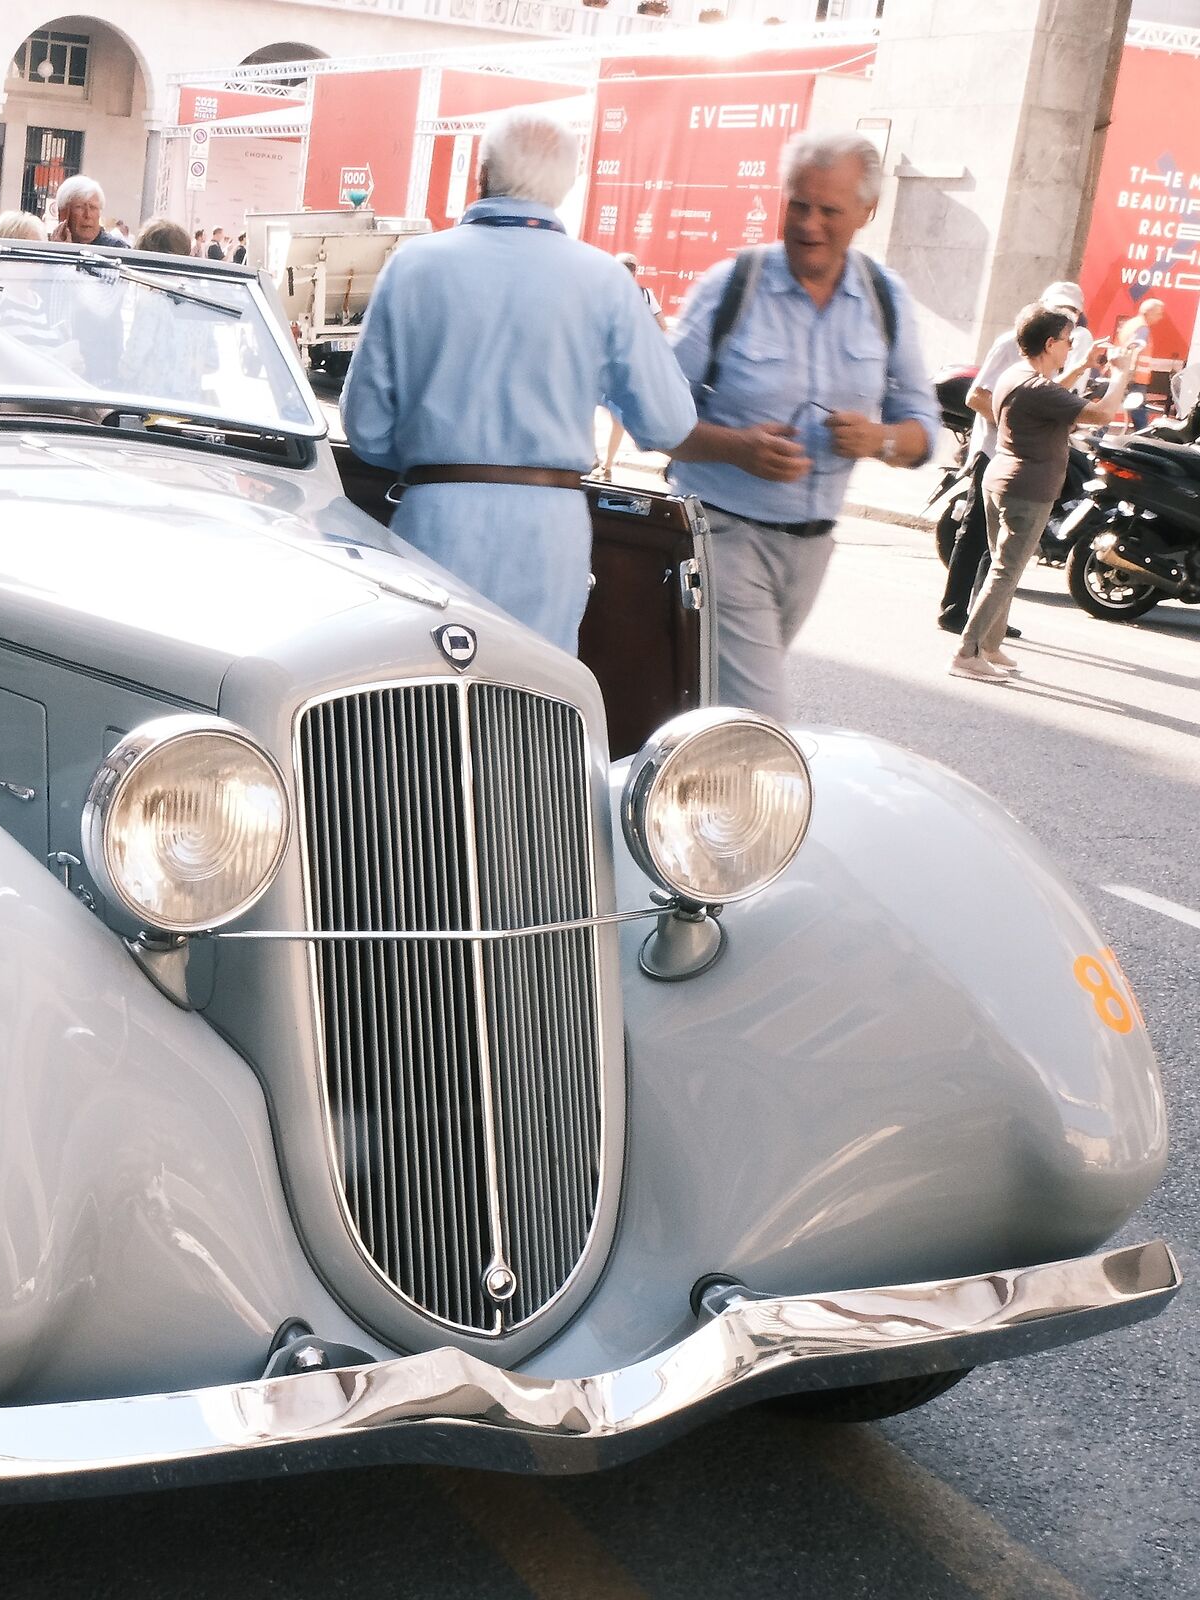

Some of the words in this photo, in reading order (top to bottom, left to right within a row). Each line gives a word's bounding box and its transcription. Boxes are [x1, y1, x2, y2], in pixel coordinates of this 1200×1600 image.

[689, 103, 798, 129] EVENTI
[244, 151, 283, 161] CHOPARD
[597, 160, 621, 175] 2022
[737, 160, 766, 177] 2023
[344, 172, 366, 185] 1000
[1130, 166, 1184, 188] THE
[1128, 243, 1148, 260] IN
[1155, 246, 1200, 266] TH
